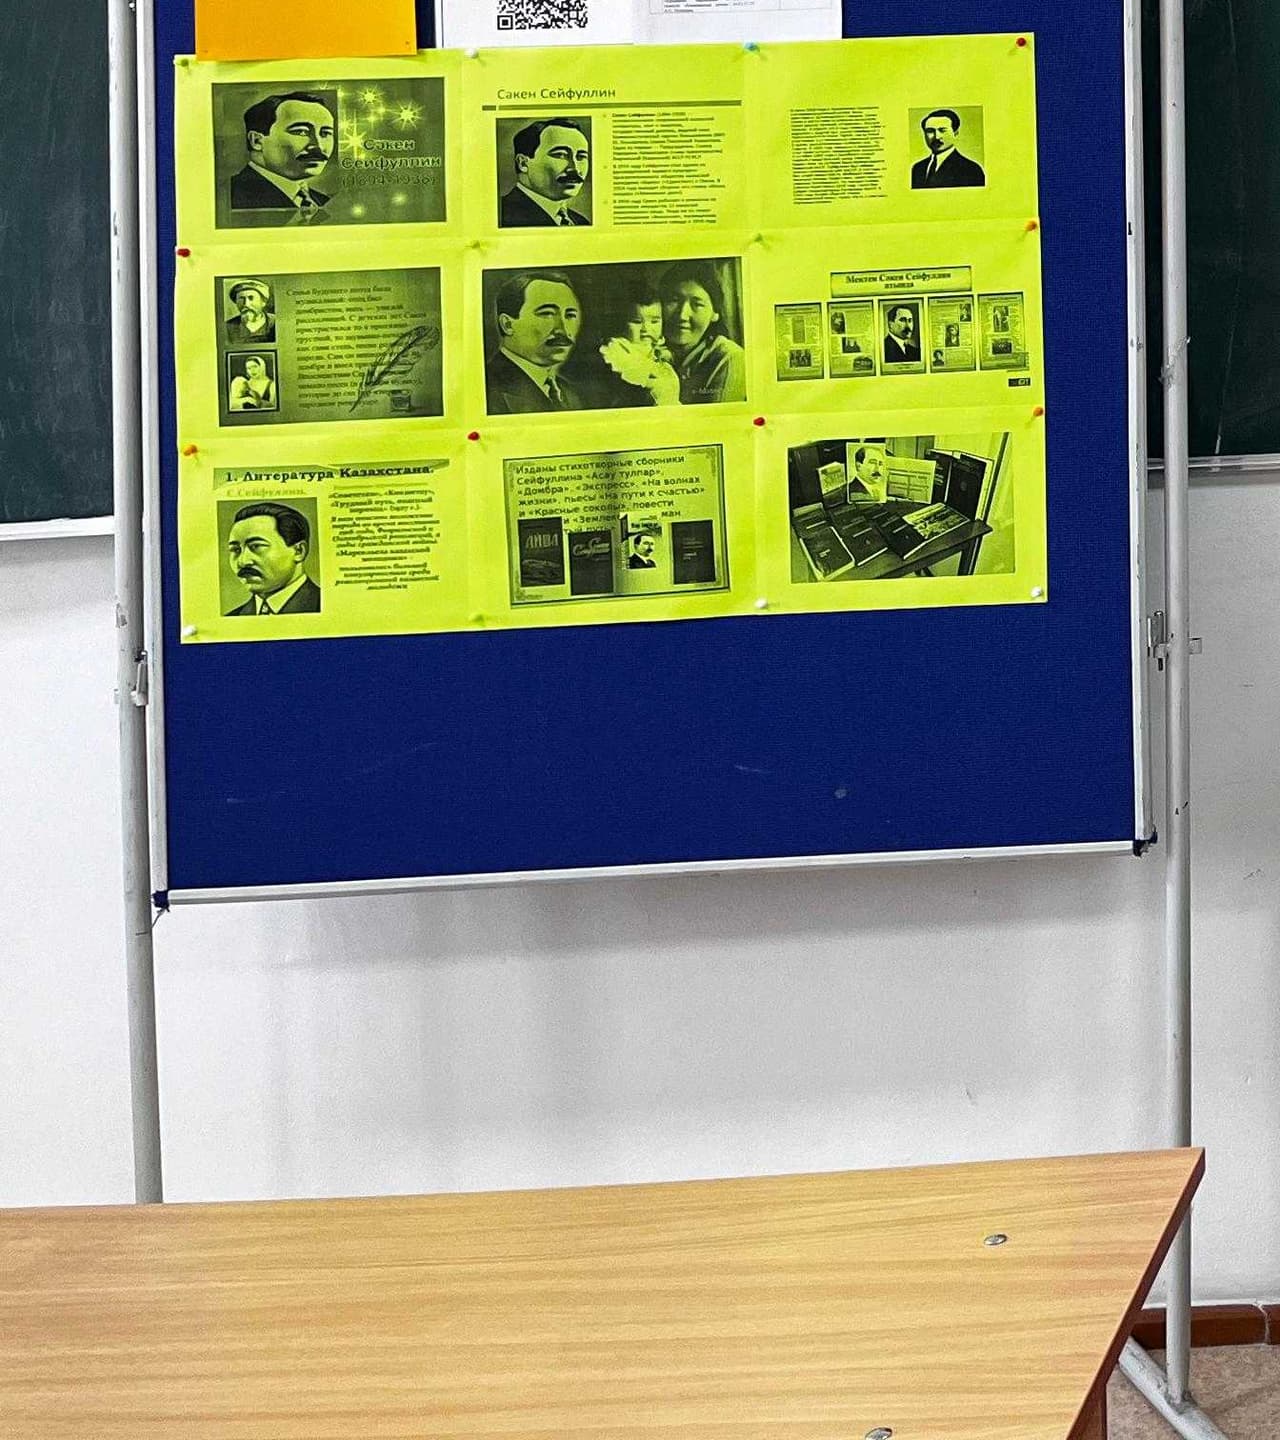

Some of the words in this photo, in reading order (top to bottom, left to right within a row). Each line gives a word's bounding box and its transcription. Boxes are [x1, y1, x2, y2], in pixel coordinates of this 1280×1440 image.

[497, 89, 536, 100] Сакен
[540, 87, 616, 100] Сейфуллин
[363, 138, 416, 152] Сәкен
[515, 465, 558, 476] Изданы
[559, 460, 634, 472] стихотворные
[636, 455, 685, 467] сборники
[226, 471, 237, 482] 1.
[243, 469, 334, 483] Литература
[339, 465, 434, 478] Казахстана.
[517, 474, 583, 486] Сейфуллина
[641, 478, 661, 487] «На
[664, 476, 701, 486] волнах
[564, 494, 596, 504] пьесы
[599, 492, 618, 501] «На
[621, 490, 647, 501] пути
[657, 486, 705, 496] счастью»
[529, 505, 578, 517] «Красные
[633, 499, 675, 509] повести
